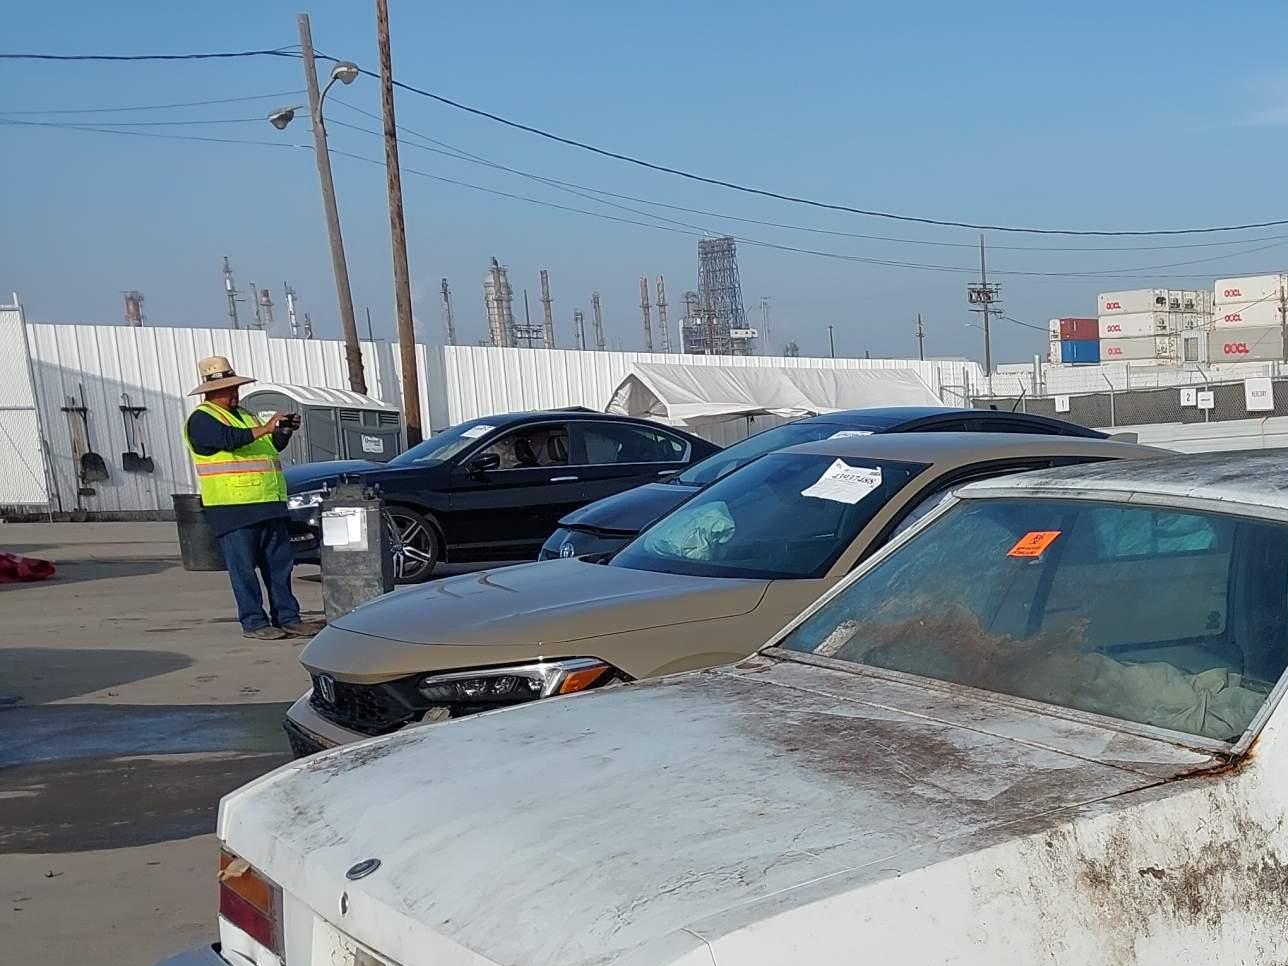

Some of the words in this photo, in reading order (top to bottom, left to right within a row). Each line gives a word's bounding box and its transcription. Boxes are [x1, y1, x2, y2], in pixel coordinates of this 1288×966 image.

[1224, 289, 1242, 297] OOCL
[1224, 314, 1242, 322] OOCL
[1224, 343, 1249, 354] OOCL
